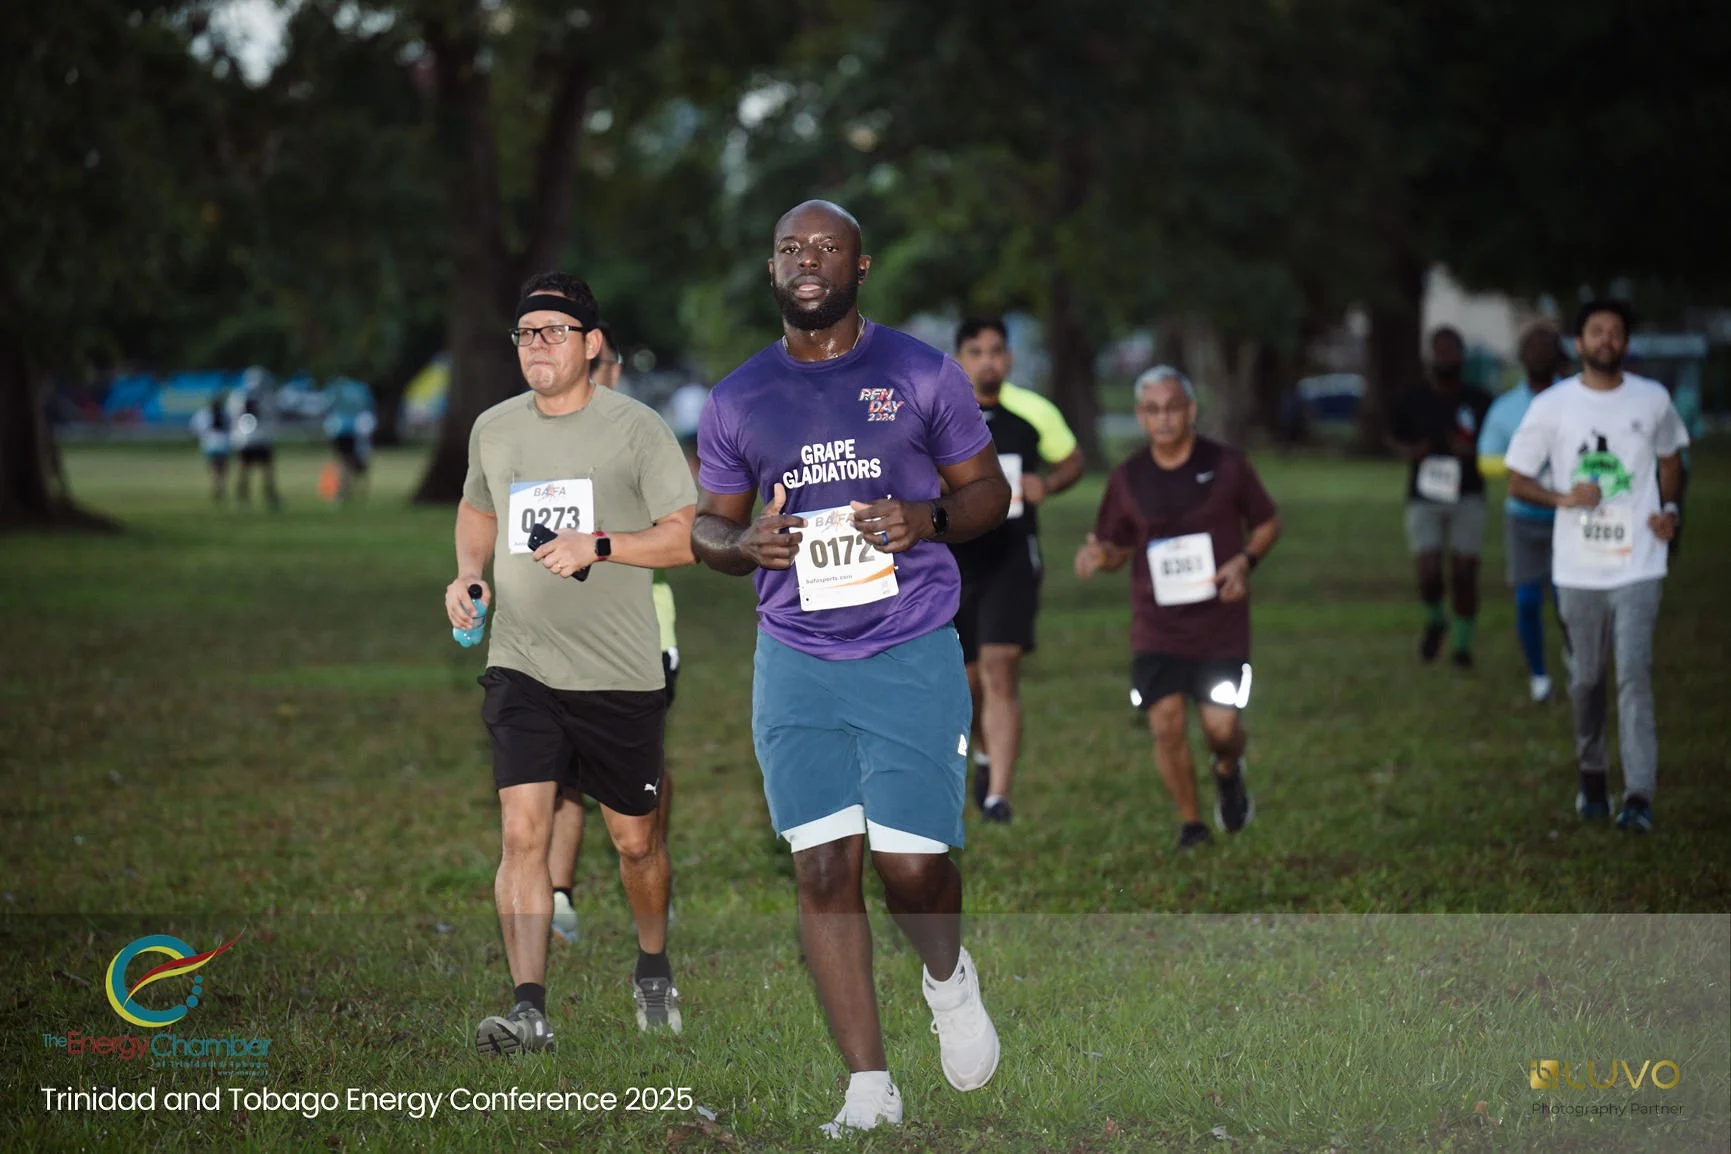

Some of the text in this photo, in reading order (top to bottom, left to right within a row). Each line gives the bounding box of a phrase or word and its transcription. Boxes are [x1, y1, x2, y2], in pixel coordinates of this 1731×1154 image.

[868, 400, 904, 412] DAY
[800, 439, 855, 465] GRAPE
[782, 457, 881, 489] GLADIATORS
[521, 506, 580, 533] 0273
[809, 533, 875, 568] 0172
